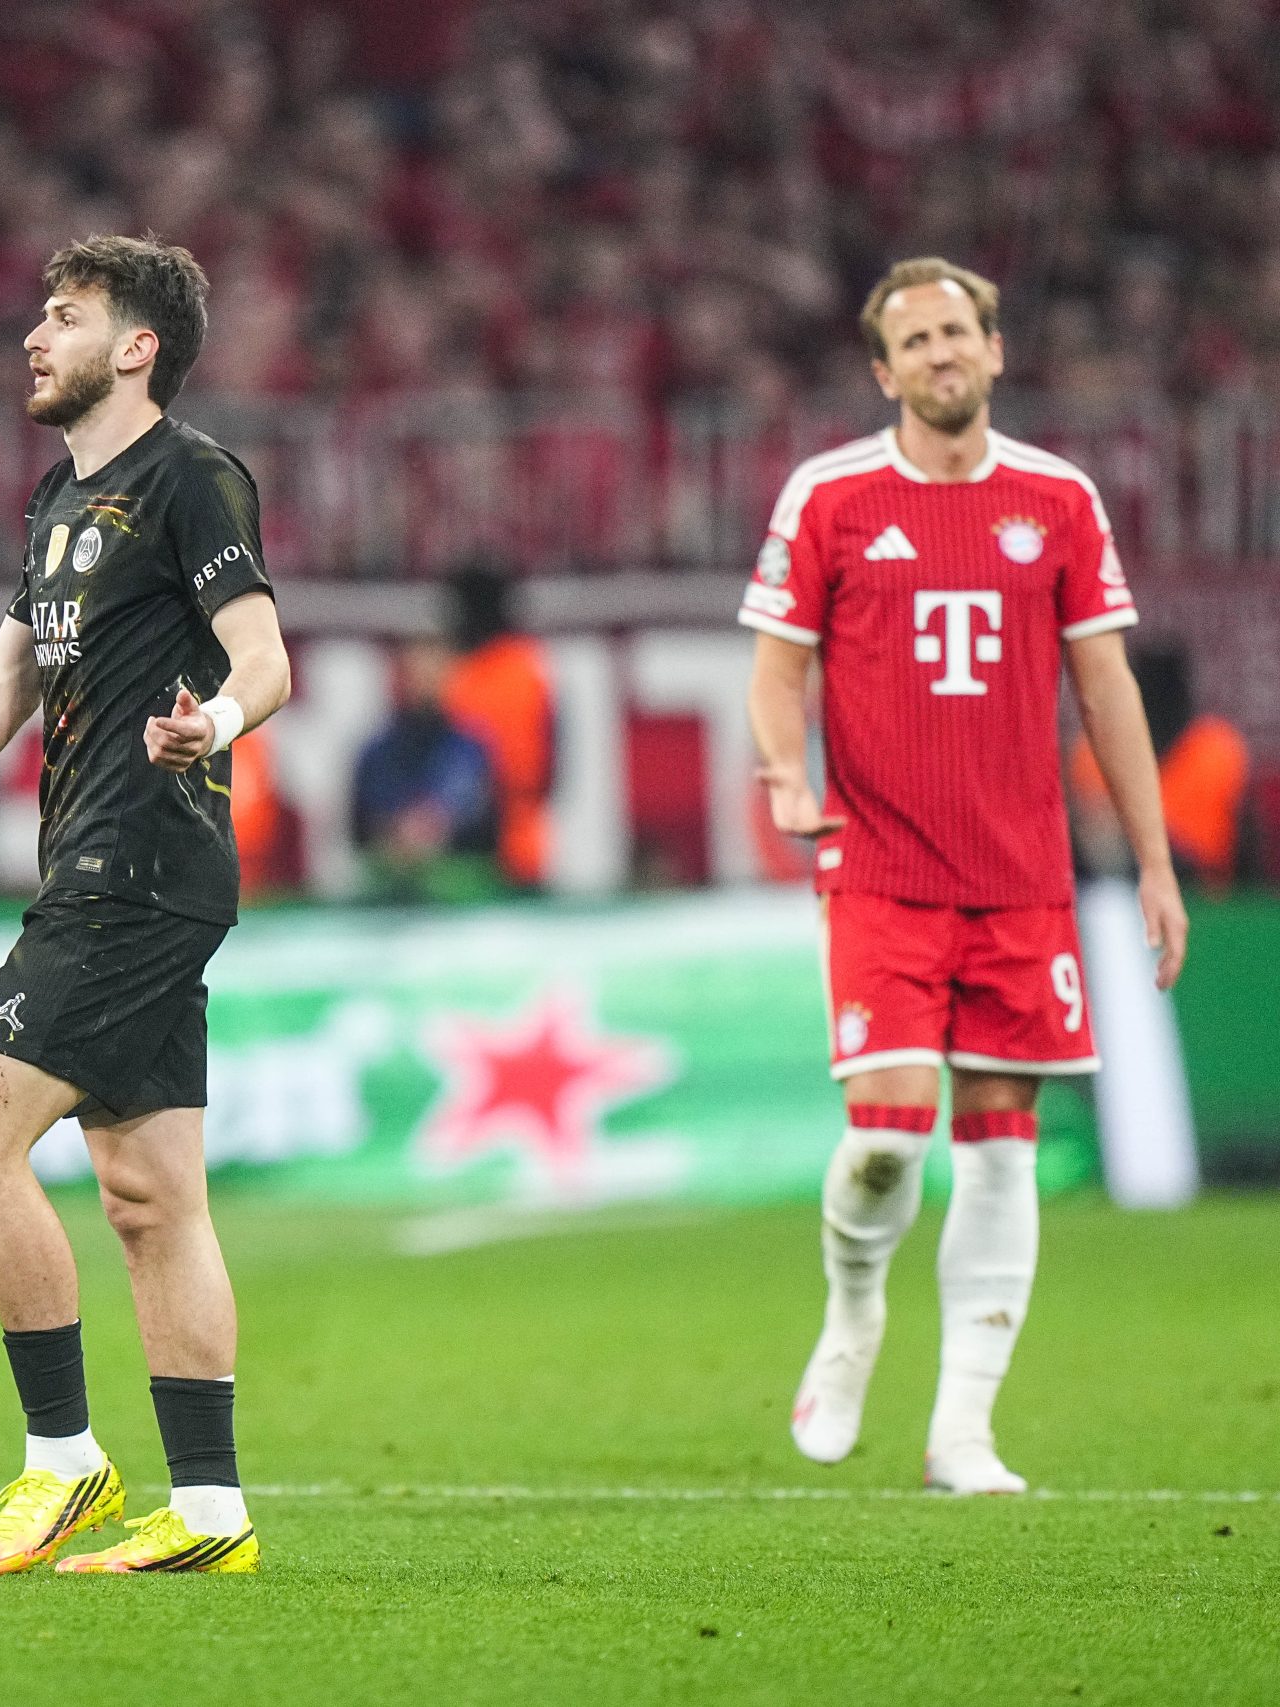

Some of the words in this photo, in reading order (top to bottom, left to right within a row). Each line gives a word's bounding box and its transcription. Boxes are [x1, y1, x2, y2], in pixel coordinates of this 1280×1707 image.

[30, 600, 81, 640] ATAR
[913, 589, 1003, 696] T
[1050, 951, 1084, 1034] 9
